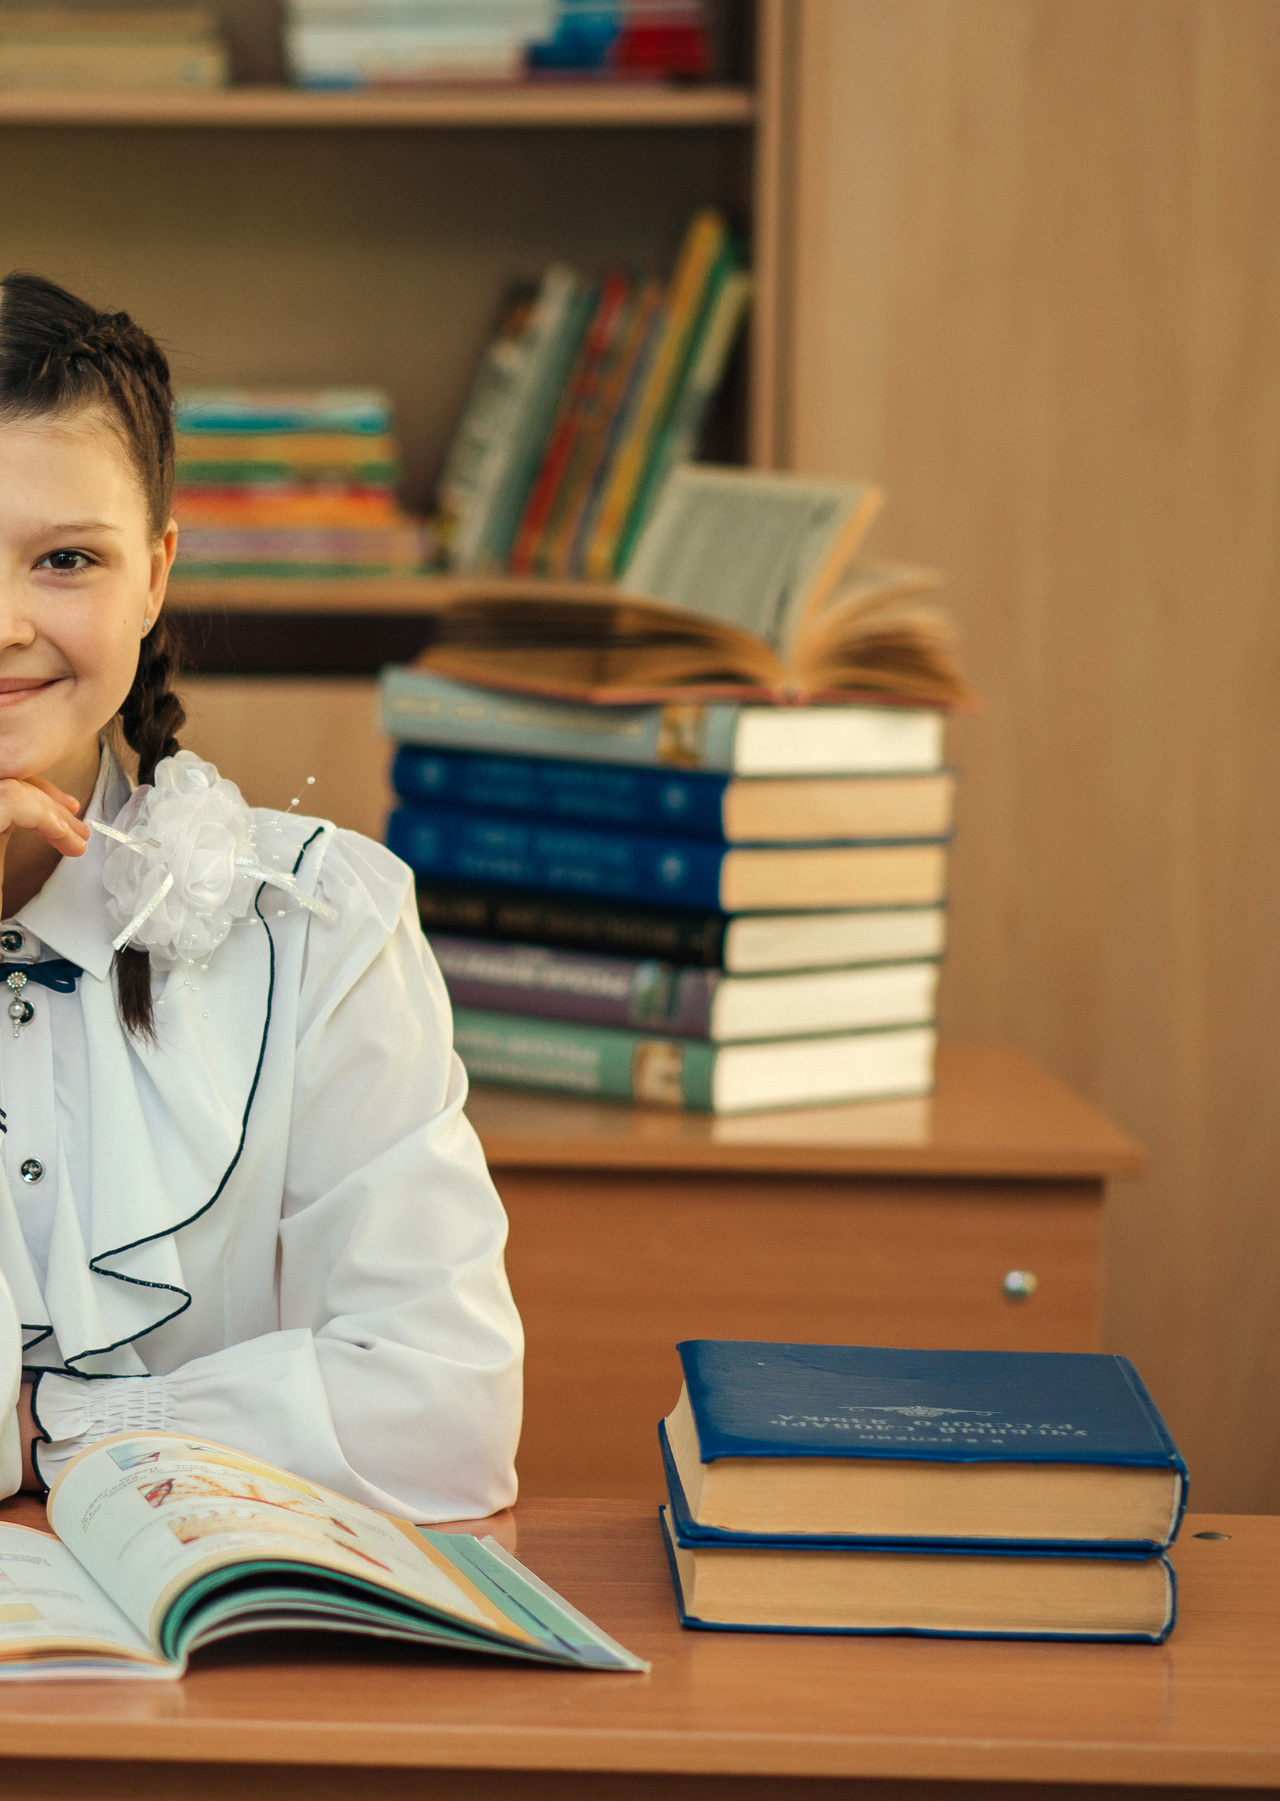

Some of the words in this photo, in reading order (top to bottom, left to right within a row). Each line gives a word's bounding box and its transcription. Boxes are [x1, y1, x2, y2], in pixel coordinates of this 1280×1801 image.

[777, 1413, 888, 1425] ЯЗЫКА
[769, 1420, 916, 1432] СЛОВАРЬ
[912, 1420, 1075, 1430] РУССКОГО
[938, 1427, 1089, 1437] УЧЕБНЫЙ
